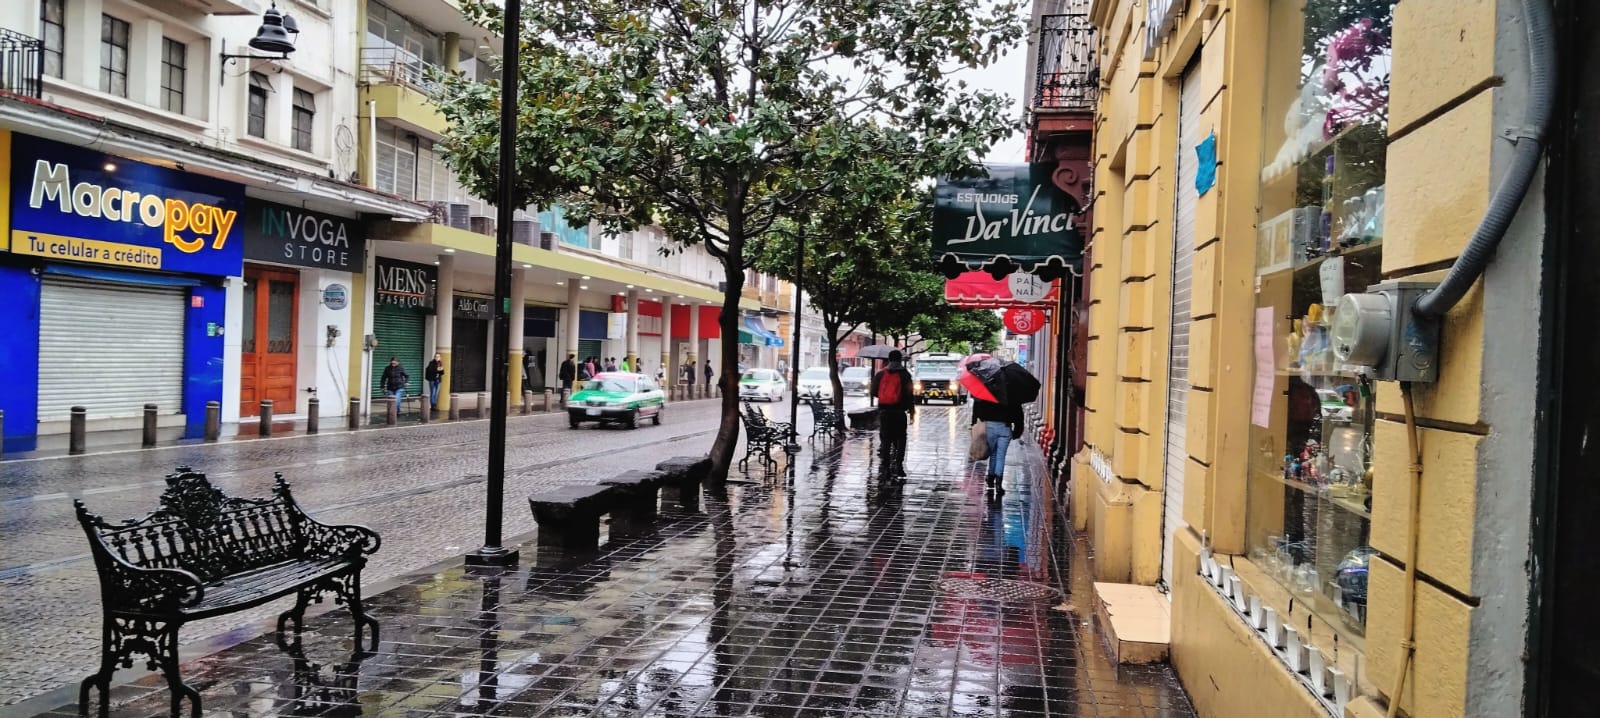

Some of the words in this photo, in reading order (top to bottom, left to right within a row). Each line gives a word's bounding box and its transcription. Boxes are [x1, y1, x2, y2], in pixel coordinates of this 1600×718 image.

[29, 159, 237, 250] Macropay
[957, 192, 1018, 204] ESTUDIOS
[262, 207, 348, 249] INVOGA
[28, 236, 45, 252] Tu
[50, 238, 99, 259] celular
[102, 249, 111, 261] a
[114, 246, 159, 265] crédito
[284, 246, 348, 266] STORE
[379, 294, 425, 307] FASHION
[458, 299, 472, 312] Aldo
